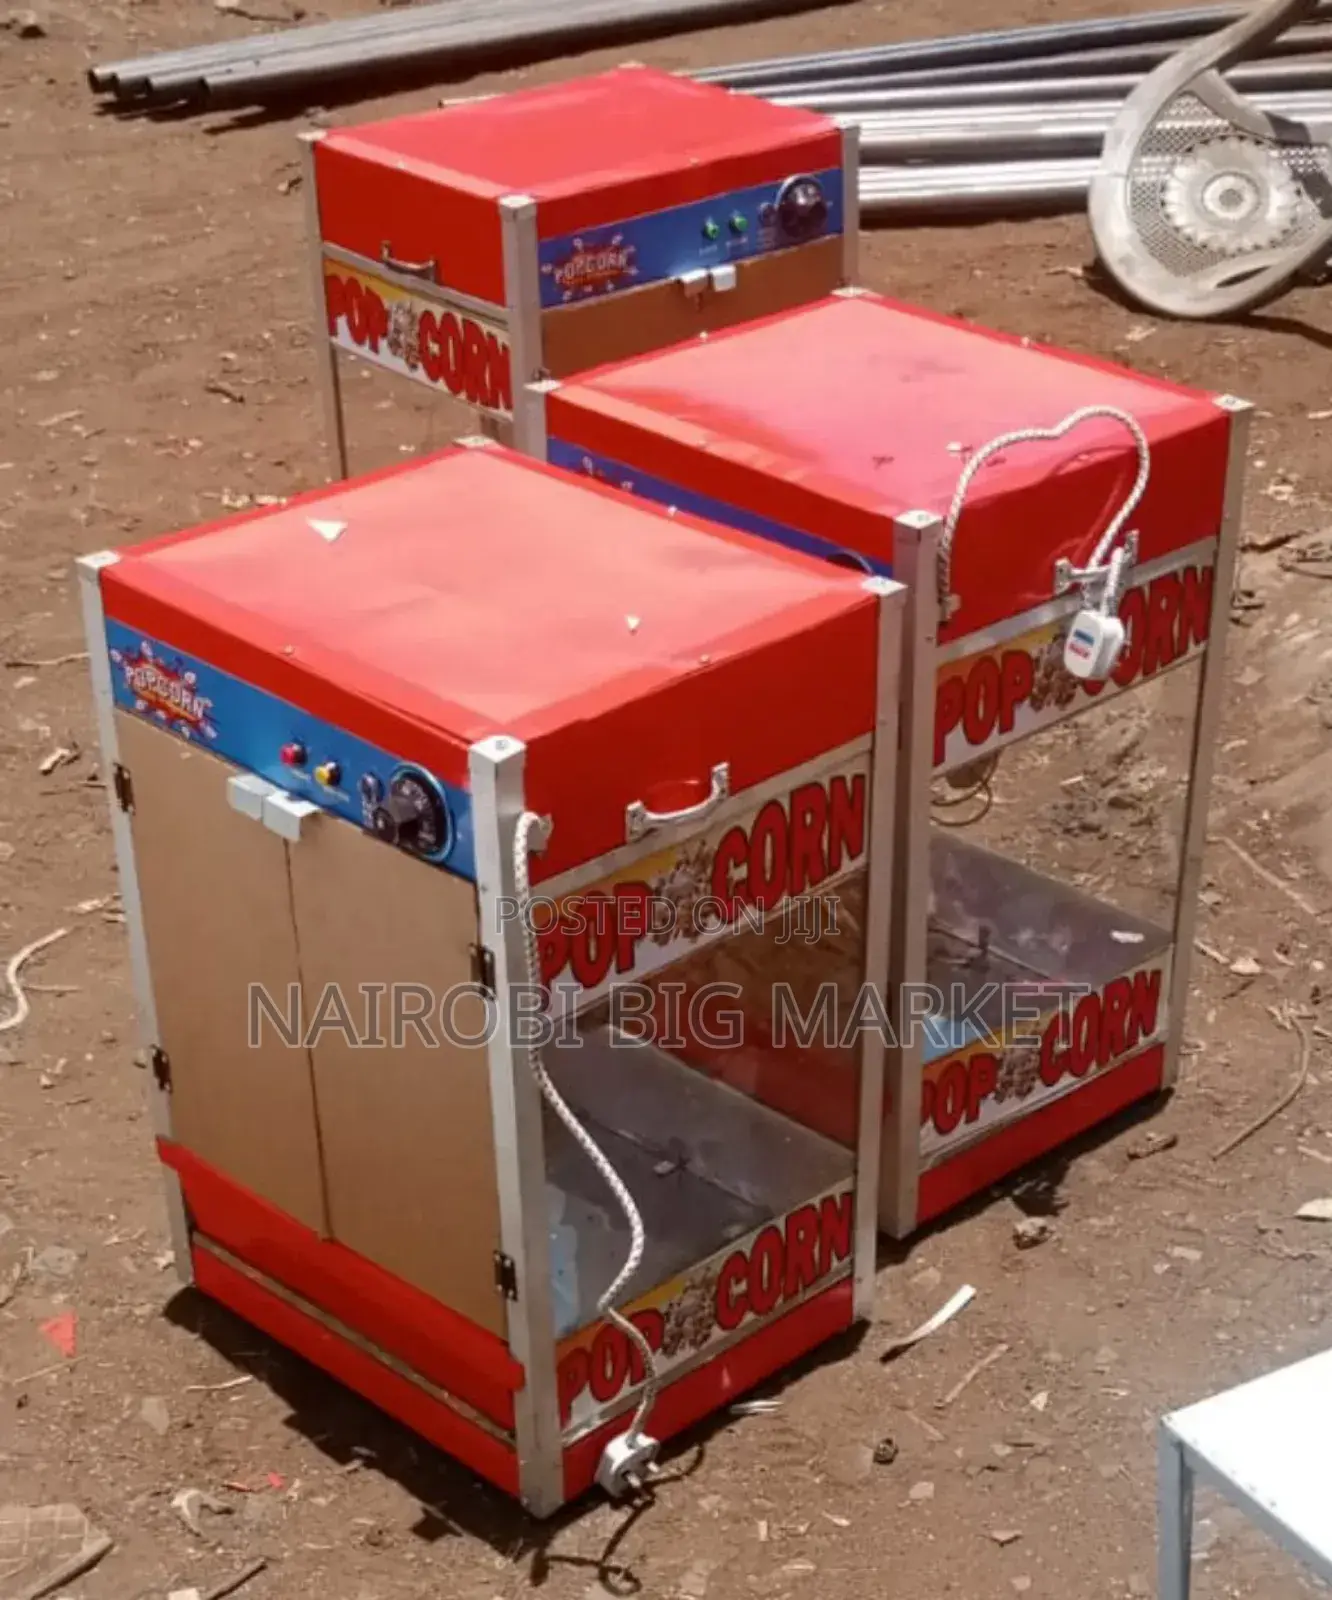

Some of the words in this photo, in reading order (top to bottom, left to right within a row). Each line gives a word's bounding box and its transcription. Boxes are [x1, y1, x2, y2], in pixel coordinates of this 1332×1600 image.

[325, 275, 388, 355] POP
[418, 310, 514, 412] CORN
[124, 661, 204, 719] POPCORN
[932, 649, 1033, 768] POP
[1082, 565, 1214, 696] ORN
[536, 880, 653, 1013] POP
[711, 774, 866, 924] CORN
[1038, 969, 1163, 1087] CORN
[556, 1308, 664, 1430] POP
[714, 1192, 854, 1331] CORN
